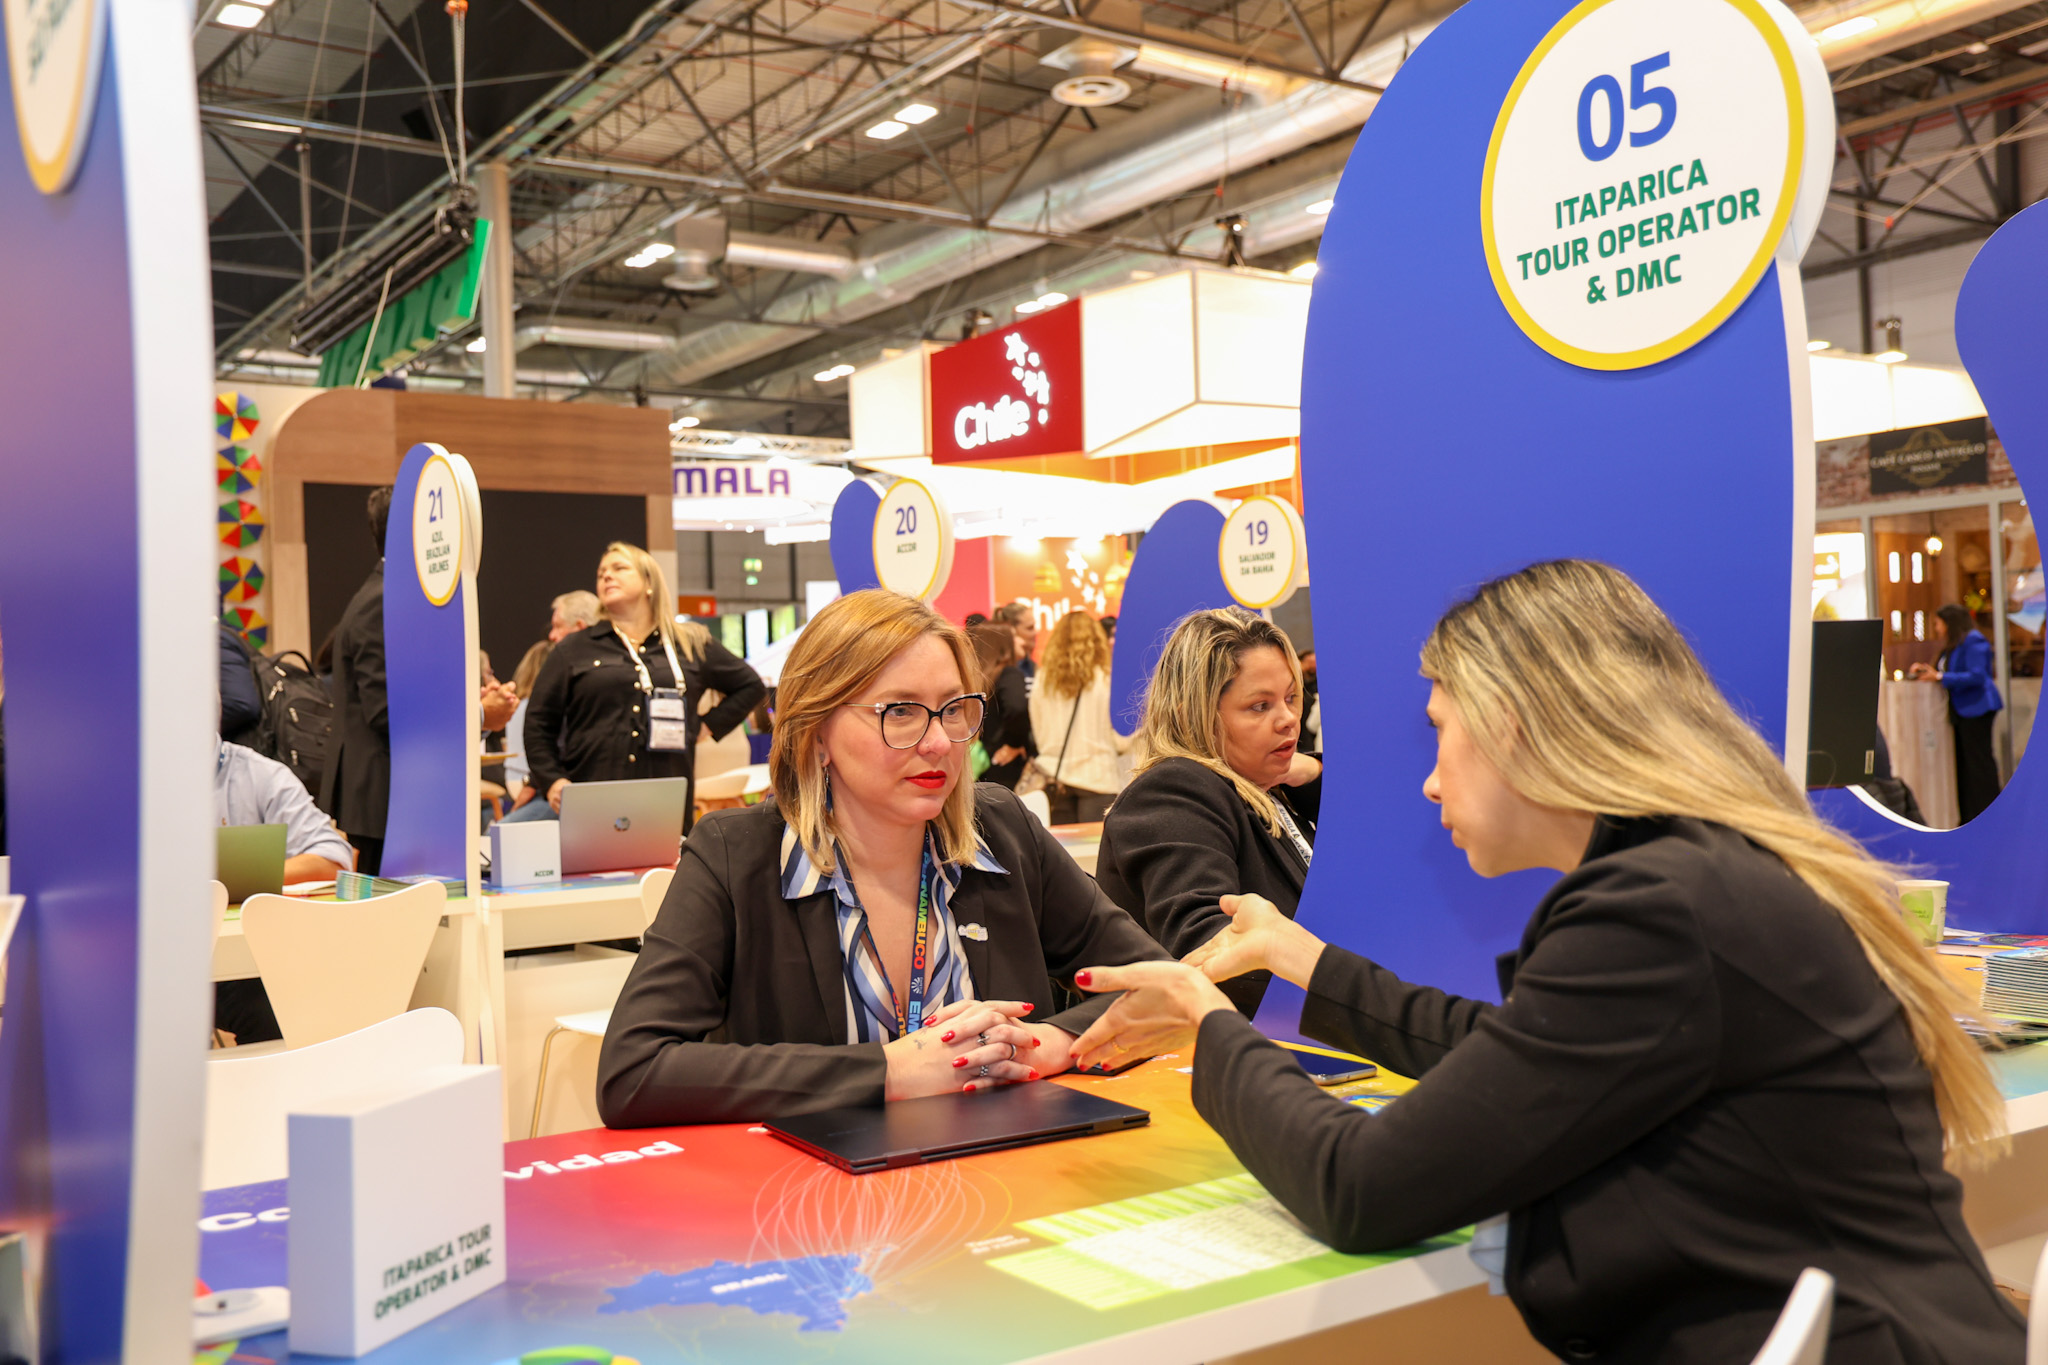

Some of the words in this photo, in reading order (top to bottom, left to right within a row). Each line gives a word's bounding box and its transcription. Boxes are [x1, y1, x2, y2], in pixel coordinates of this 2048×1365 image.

[1577, 51, 1677, 162] 05
[1555, 158, 1709, 230] ITAPARICA
[1516, 236, 1590, 281] TOUR
[1597, 187, 1761, 259] OPERATOR
[1586, 275, 1607, 304] &
[1615, 253, 1683, 298] DMC
[954, 394, 1031, 450] Chile
[673, 467, 789, 495] MALA
[428, 486, 443, 523] 21
[895, 505, 917, 536] 20
[1245, 520, 1268, 546] 19
[426, 544, 450, 560] BRAZILIAN
[896, 542, 917, 554] ACCOR
[1239, 551, 1275, 563] SALVADOR
[428, 559, 449, 575] AIRLINES
[1241, 567, 1250, 575] DA
[535, 869, 554, 877] ACCOR
[383, 1240, 453, 1290] ITAPARICA
[458, 1223, 491, 1249] TOUR
[375, 1269, 448, 1320] OPERATOR
[451, 1268, 459, 1283] &
[465, 1248, 492, 1276] DMC
